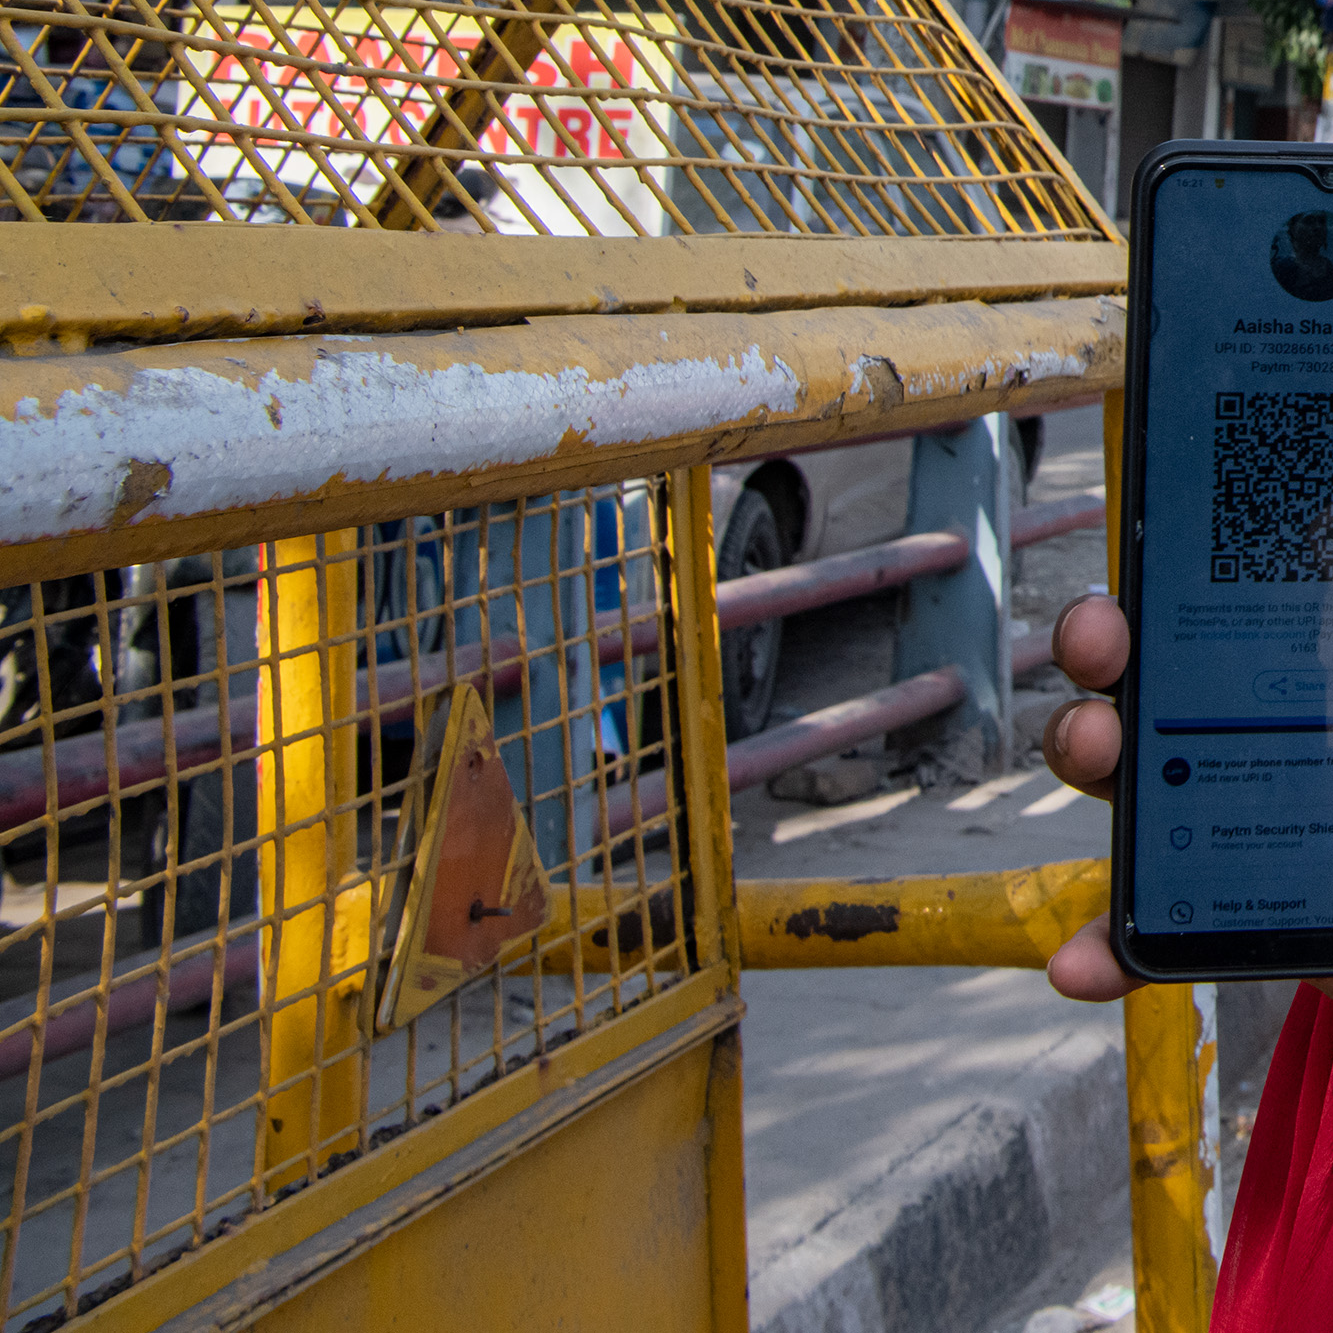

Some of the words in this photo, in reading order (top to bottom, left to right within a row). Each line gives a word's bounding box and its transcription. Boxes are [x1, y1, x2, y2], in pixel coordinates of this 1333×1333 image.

[388, 101, 633, 160] CNTRE
[1176, 177, 1203, 189] 16:21
[1233, 318, 1294, 334] Aaisha
[1214, 342, 1236, 353] UPI
[1239, 342, 1255, 354] ID:
[1250, 361, 1293, 375] Paytm:
[1178, 603, 1232, 616] Payments
[1235, 603, 1265, 613] made
[1267, 603, 1279, 613] to
[1281, 602, 1301, 613] this
[1304, 602, 1320, 613] QR
[1231, 618, 1242, 627] or
[1244, 618, 1264, 630] any
[1267, 617, 1294, 627] other
[1297, 616, 1316, 627] UPI
[1174, 631, 1197, 642] your
[1234, 630, 1260, 640] bank
[1263, 630, 1305, 640] account
[1295, 681, 1325, 692] Share
[1198, 759, 1222, 769] Hide
[1224, 759, 1247, 771] your
[1250, 758, 1281, 770] phone
[1284, 758, 1324, 768] number
[1198, 773, 1217, 783] Add
[1219, 774, 1240, 783] new
[1242, 772, 1260, 783] UPI
[1262, 772, 1273, 782] ID
[1211, 824, 1252, 839] Paytm
[1254, 823, 1306, 838] Security
[1211, 840, 1244, 850] Protect
[1246, 840, 1266, 851] your
[1267, 839, 1303, 849] account
[1212, 900, 1242, 913] Help
[1245, 899, 1254, 911] &
[1257, 898, 1307, 912] Support
[1212, 916, 1264, 928] Customer
